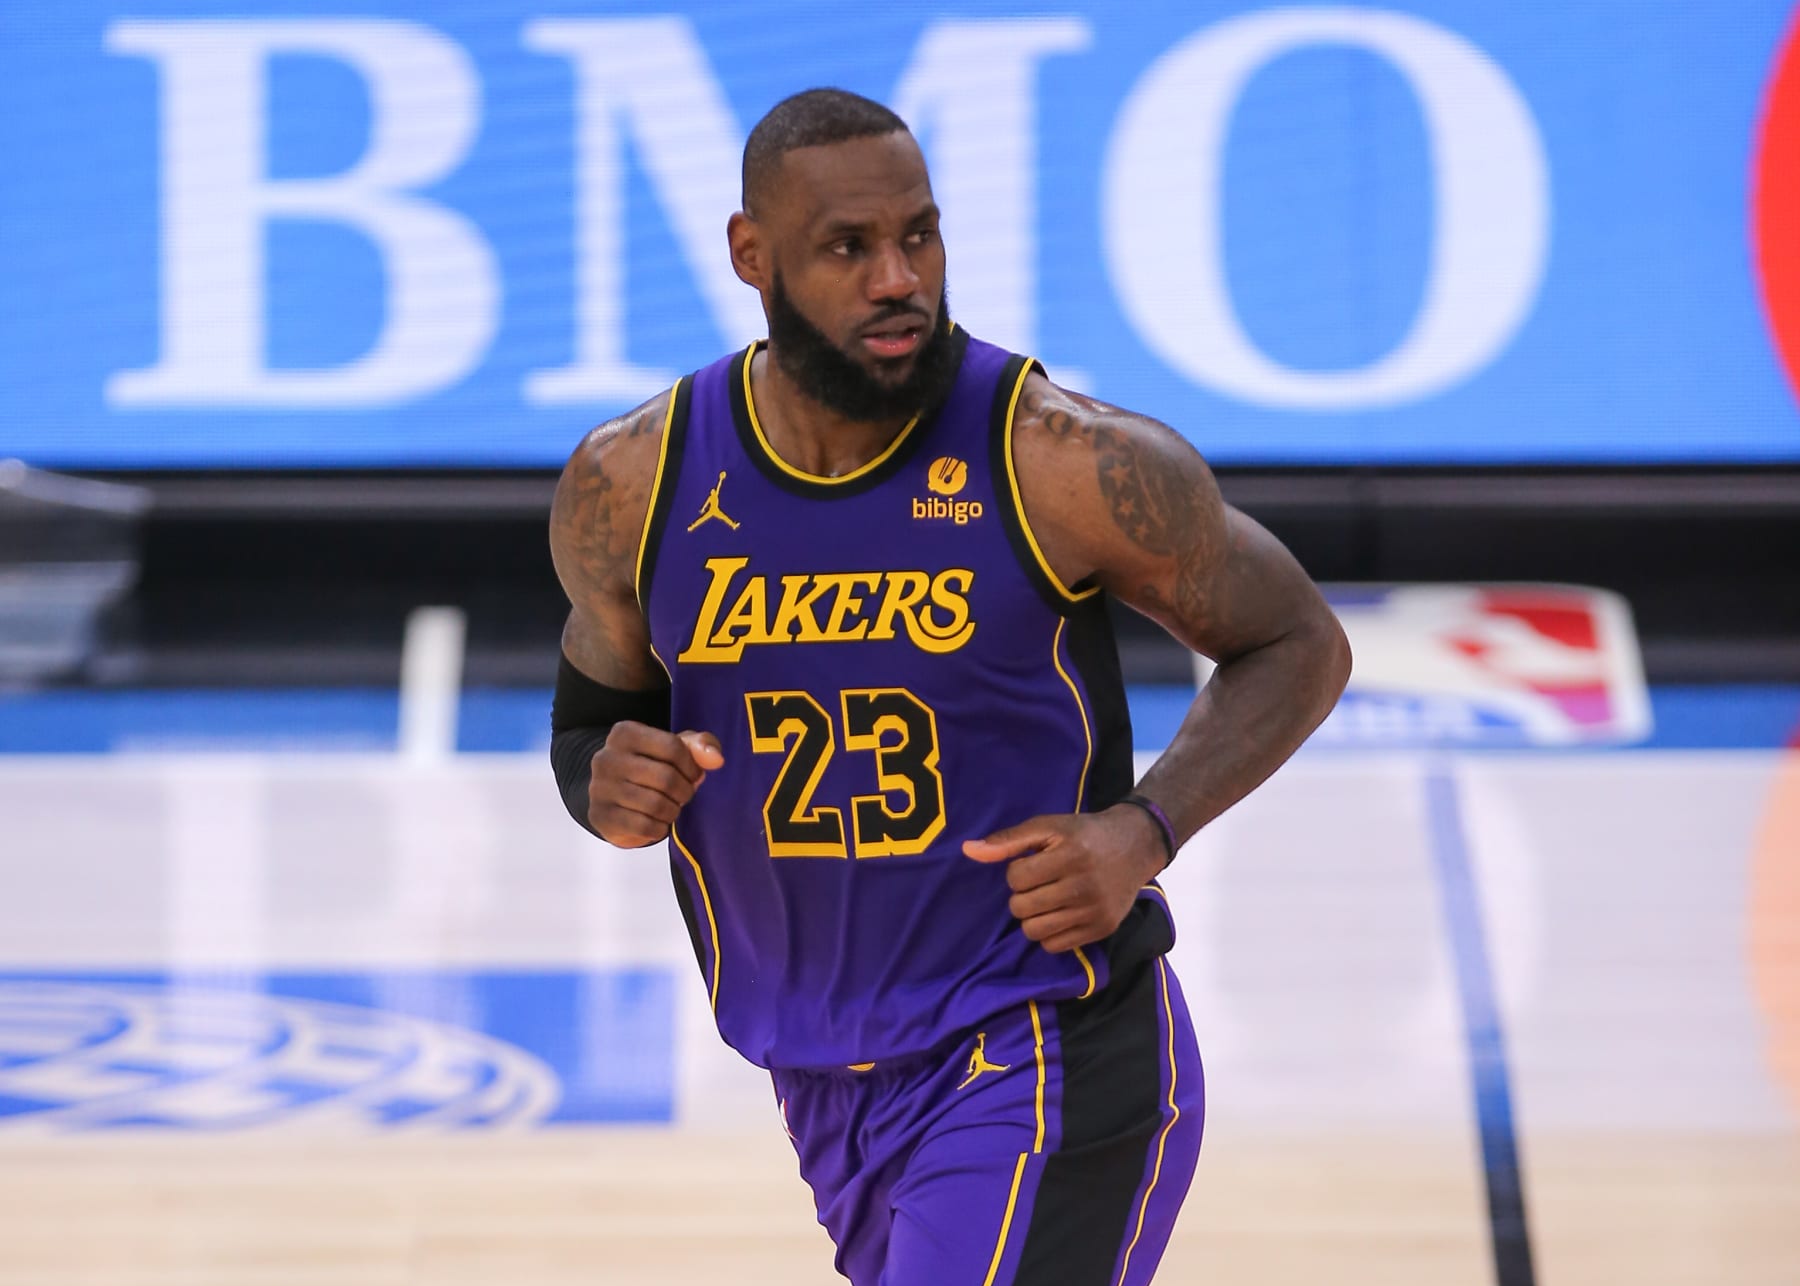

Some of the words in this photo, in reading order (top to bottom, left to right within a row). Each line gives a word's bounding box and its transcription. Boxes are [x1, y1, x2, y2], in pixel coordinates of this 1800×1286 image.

[105, 8, 1552, 409] BMO
[911, 497, 984, 525] bibigo
[677, 556, 977, 664] LAKERS
[744, 687, 948, 859] 23
